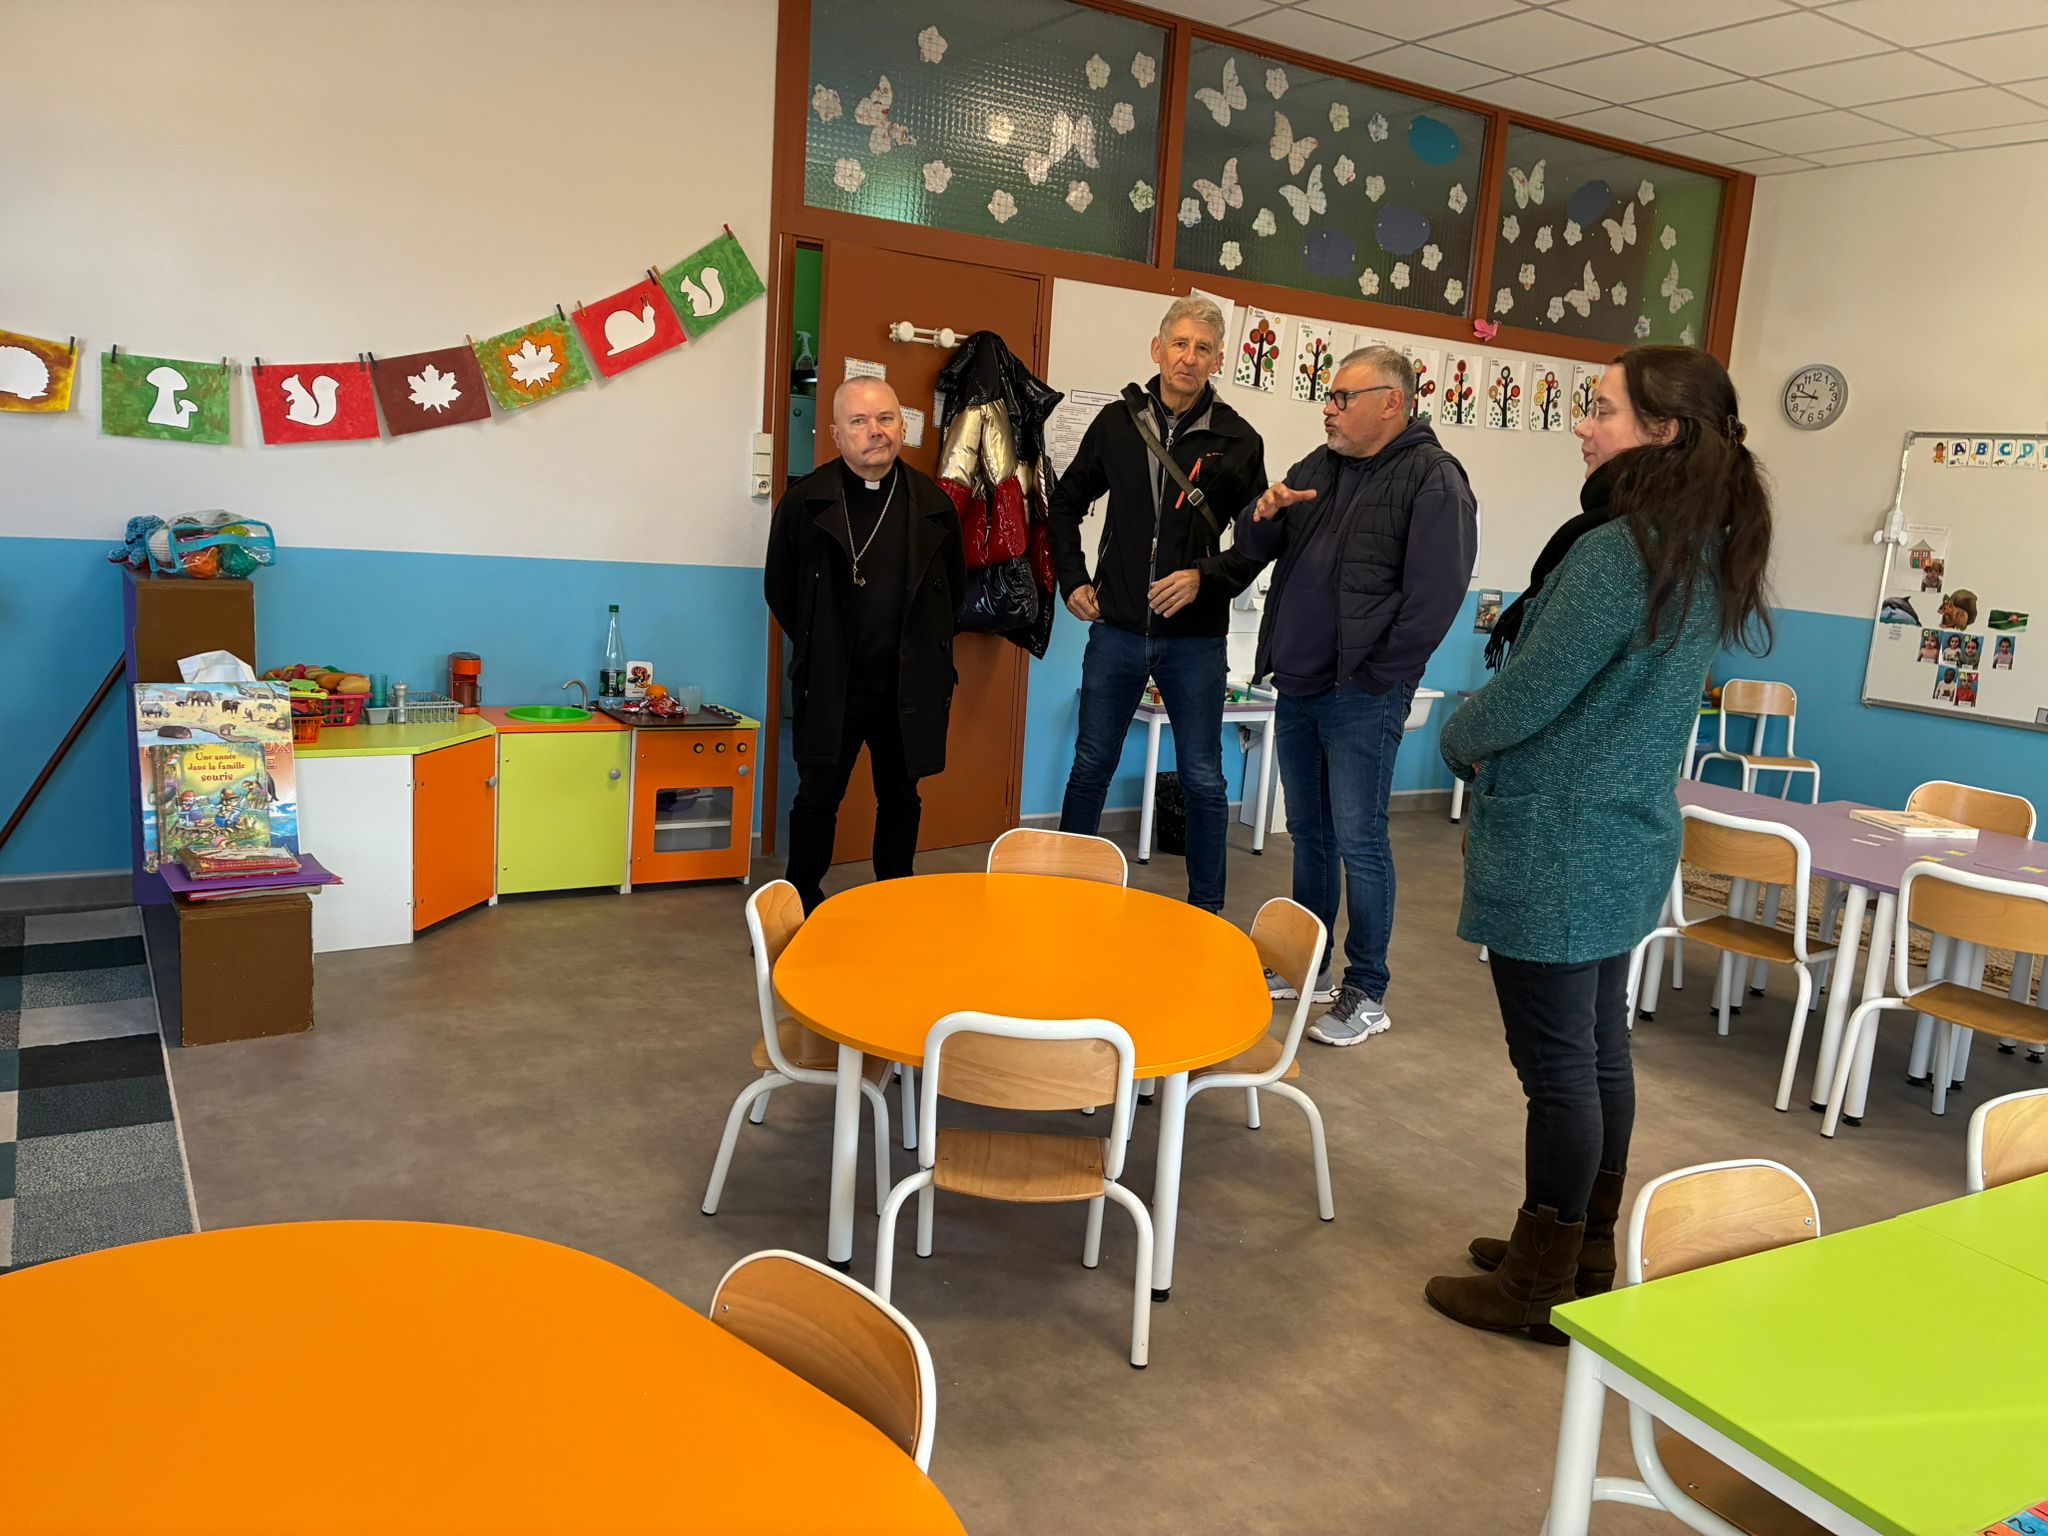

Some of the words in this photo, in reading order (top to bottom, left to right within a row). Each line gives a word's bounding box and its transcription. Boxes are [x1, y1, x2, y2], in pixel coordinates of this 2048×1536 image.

[1804, 375, 1811, 384] 11
[1813, 372, 1822, 382] 12
[1824, 375, 1829, 384] 1
[1829, 382, 1836, 391] 2
[1791, 393, 1797, 402] 9
[1831, 392, 1837, 401] 3
[1792, 403, 1798, 412] 8
[1826, 403, 1832, 411] 4
[1800, 410, 1805, 419] 7
[1807, 413, 1814, 422] 6
[1817, 410, 1824, 419] 5
[1954, 443, 1966, 456] A
[1976, 443, 1987, 455] B
[2000, 443, 2012, 456] C
[2022, 443, 2034, 456] D
[195, 752, 213, 760] Une
[208, 762, 216, 770] la
[218, 761, 246, 769] famille
[201, 771, 233, 781] souris
[2007, 1517, 2036, 1534] 2
